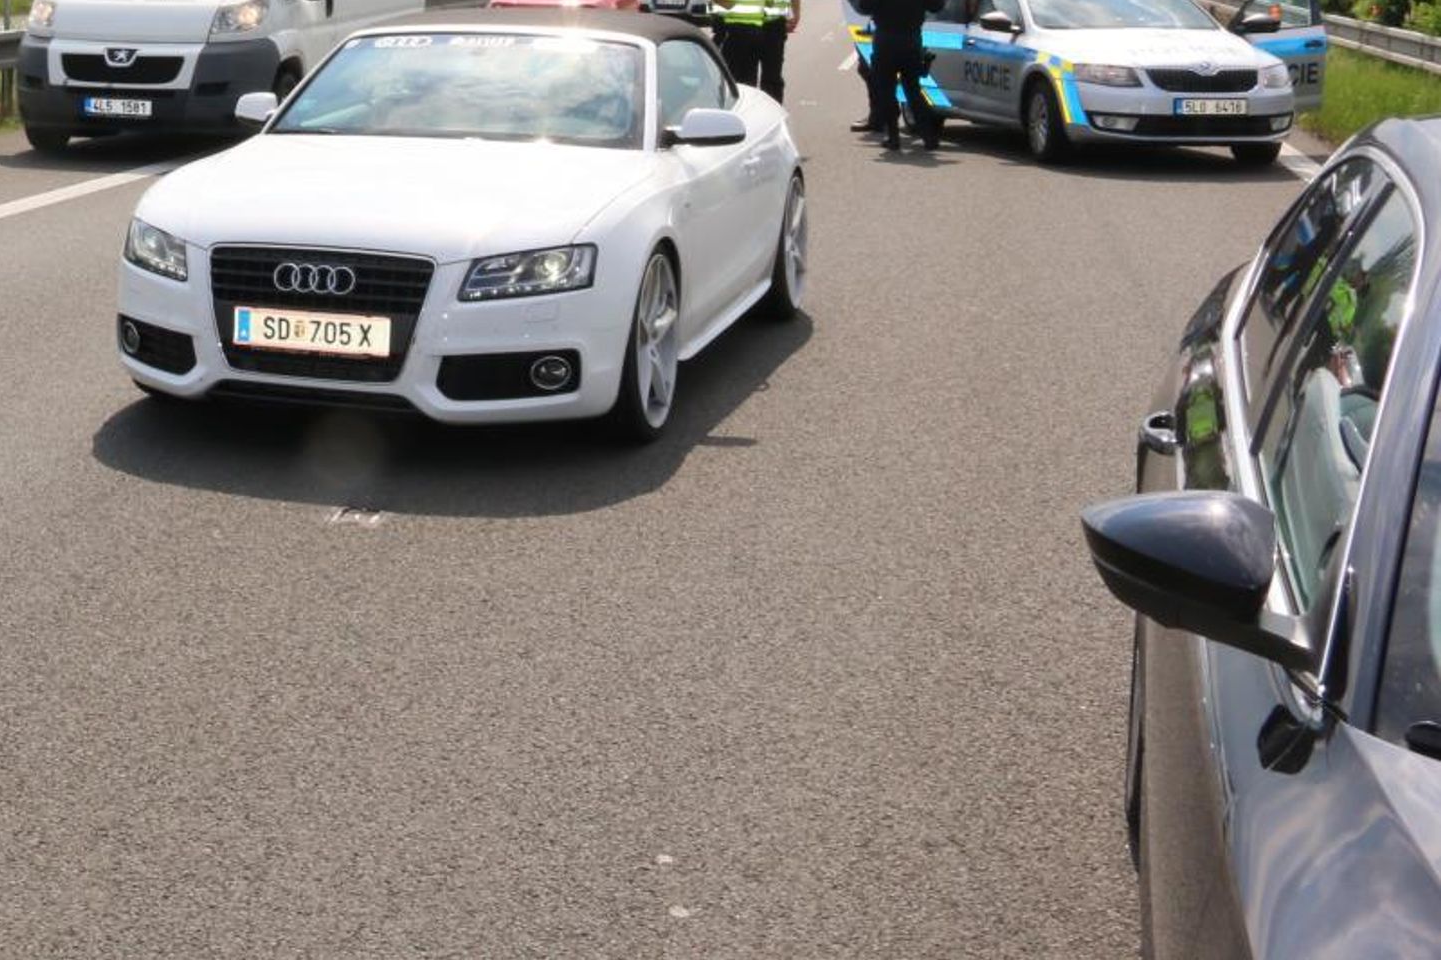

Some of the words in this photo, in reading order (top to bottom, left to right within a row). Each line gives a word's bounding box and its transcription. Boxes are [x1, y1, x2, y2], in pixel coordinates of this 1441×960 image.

[964, 60, 1011, 90] POLICIE
[263, 316, 290, 340] SD
[309, 320, 352, 346] 705
[359, 323, 372, 347] X
